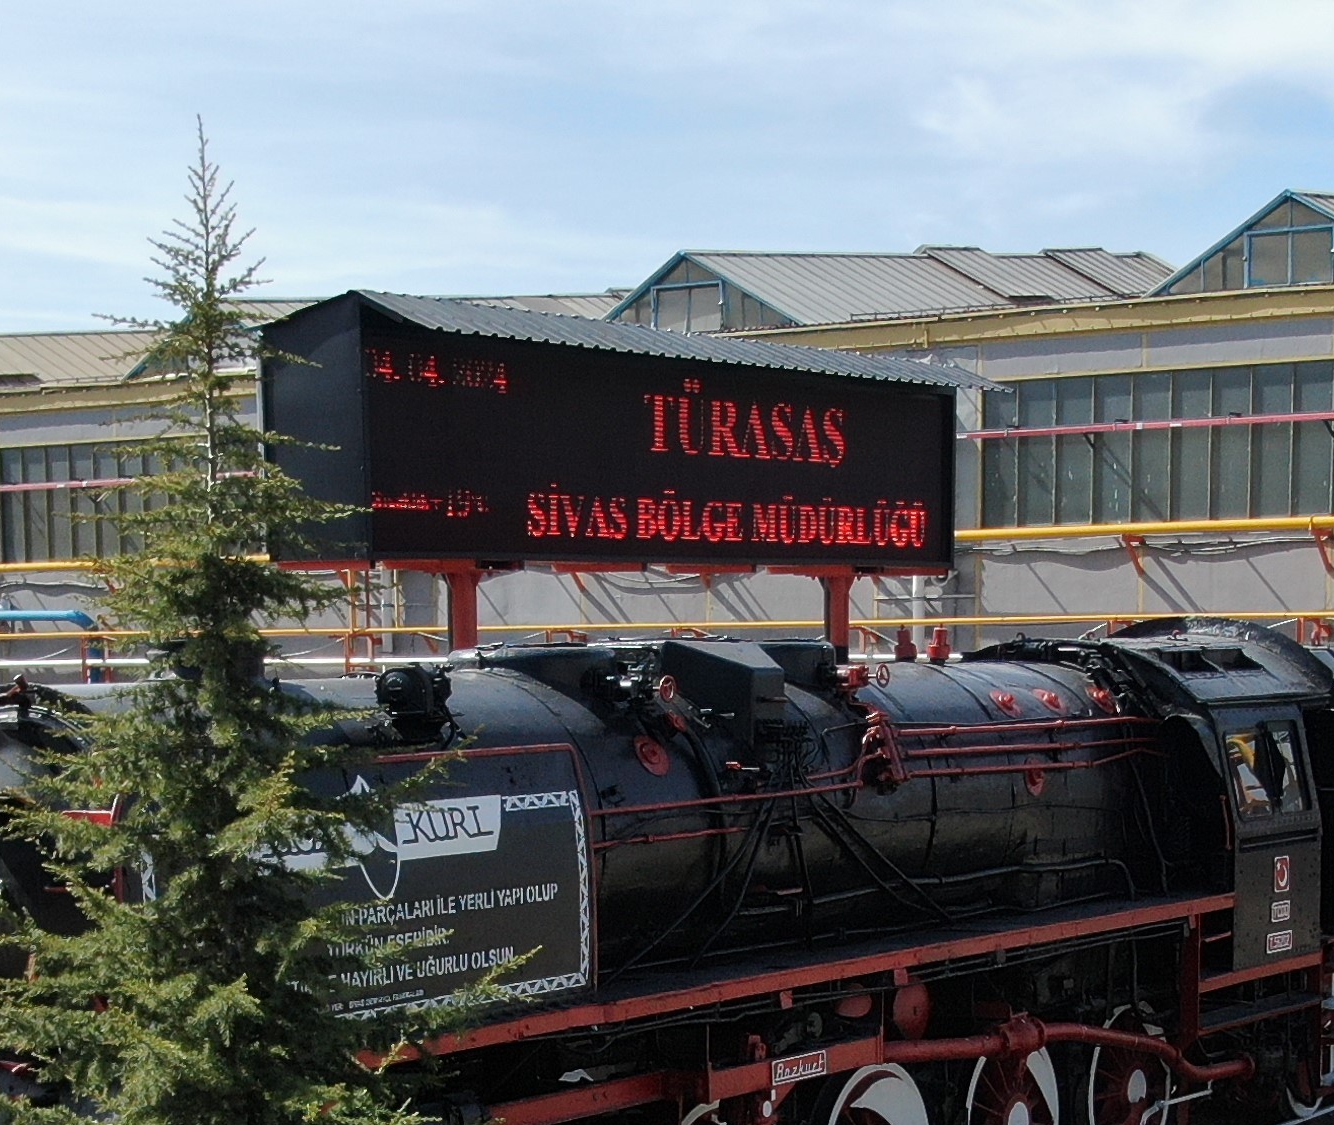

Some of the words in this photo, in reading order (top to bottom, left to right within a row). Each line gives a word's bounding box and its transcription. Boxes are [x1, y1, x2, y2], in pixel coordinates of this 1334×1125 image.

[644, 378, 846, 468] TÜRASAŞ
[527, 483, 627, 539] SİVAS
[636, 489, 744, 543] BÖLGE
[751, 495, 928, 548] MÜDÜRLÜĞÜ
[359, 900, 435, 926] PARÇALARI
[436, 893, 456, 915] İLE
[458, 888, 494, 911] YERLİ
[497, 886, 524, 907] YAPI
[526, 882, 559, 903] OLUP
[396, 962, 414, 982] VE
[417, 952, 468, 978] UĞURLU
[471, 945, 515, 969] OLSUN
